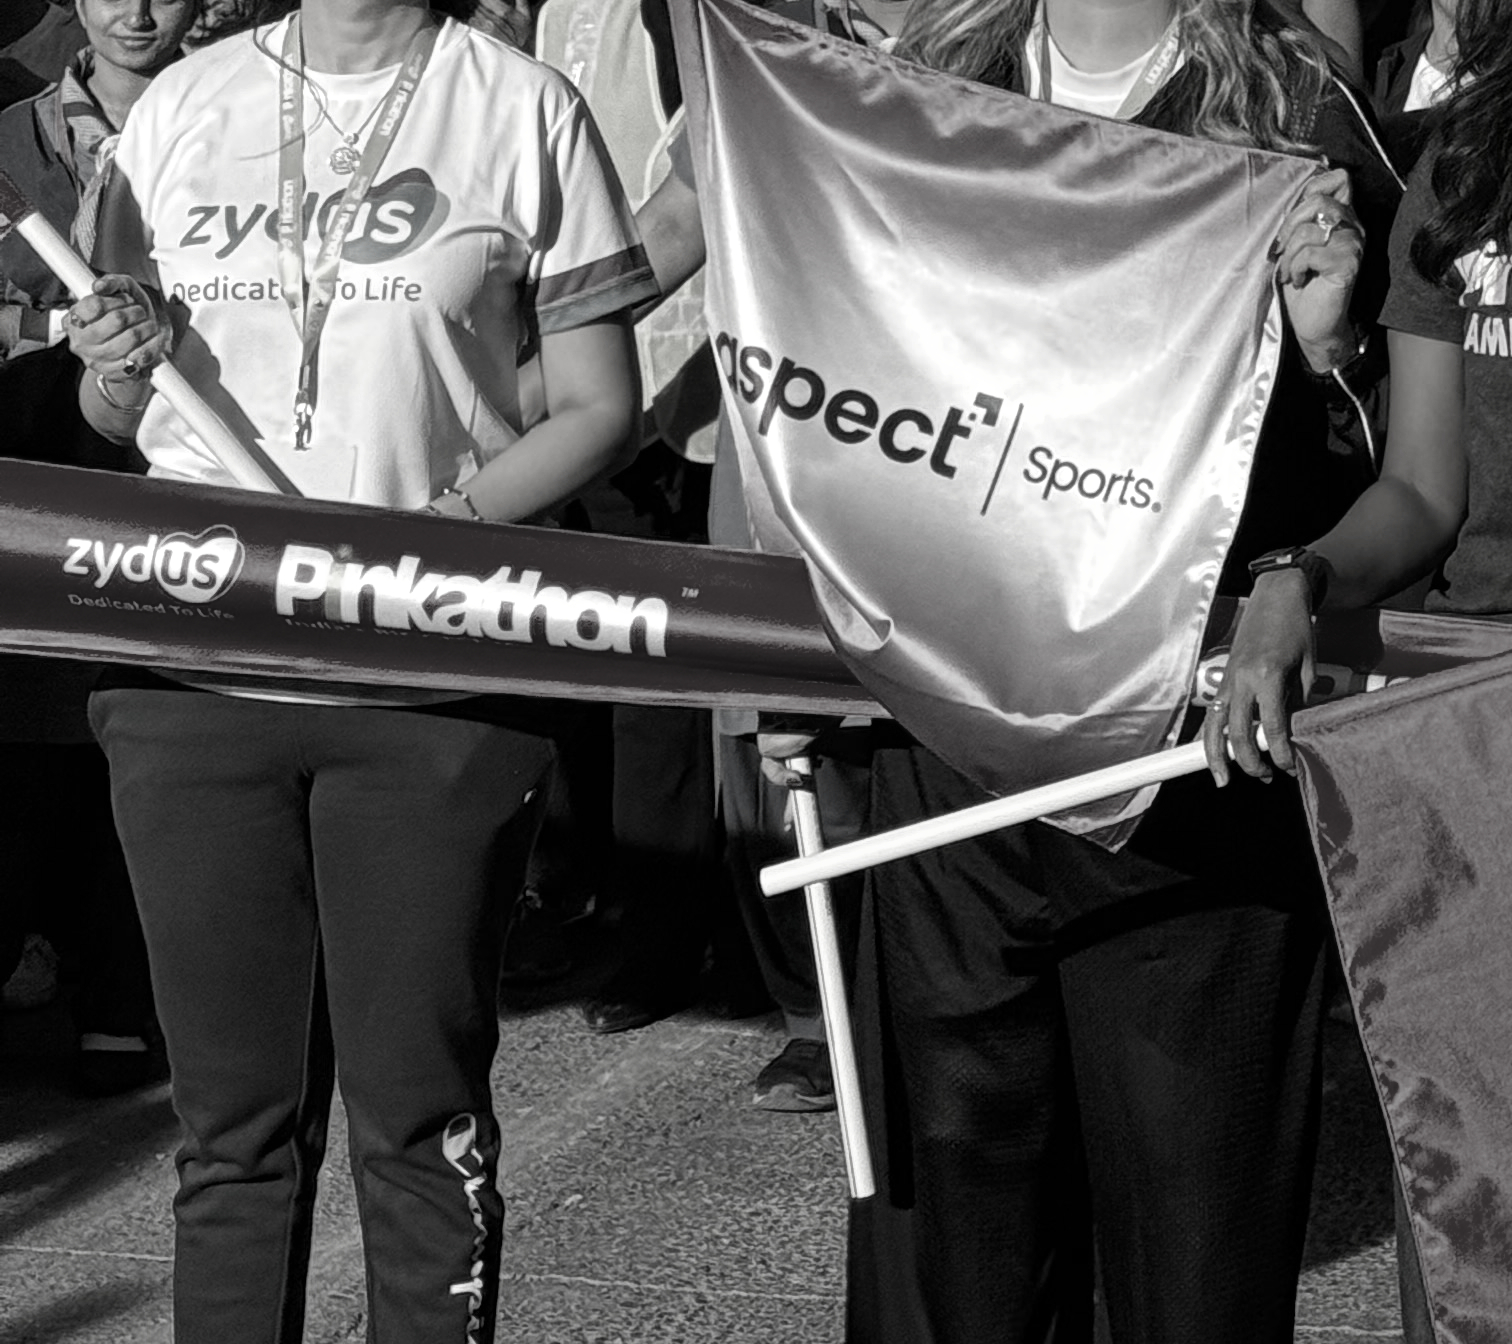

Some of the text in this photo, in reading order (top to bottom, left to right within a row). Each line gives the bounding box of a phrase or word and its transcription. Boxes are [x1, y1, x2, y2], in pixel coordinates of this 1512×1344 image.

[364, 275, 422, 302] Life
[714, 330, 1163, 513] aspect sports.
[62, 533, 222, 591] zydus
[67, 593, 165, 614] Dedicated
[275, 543, 669, 658] Pinkathon
